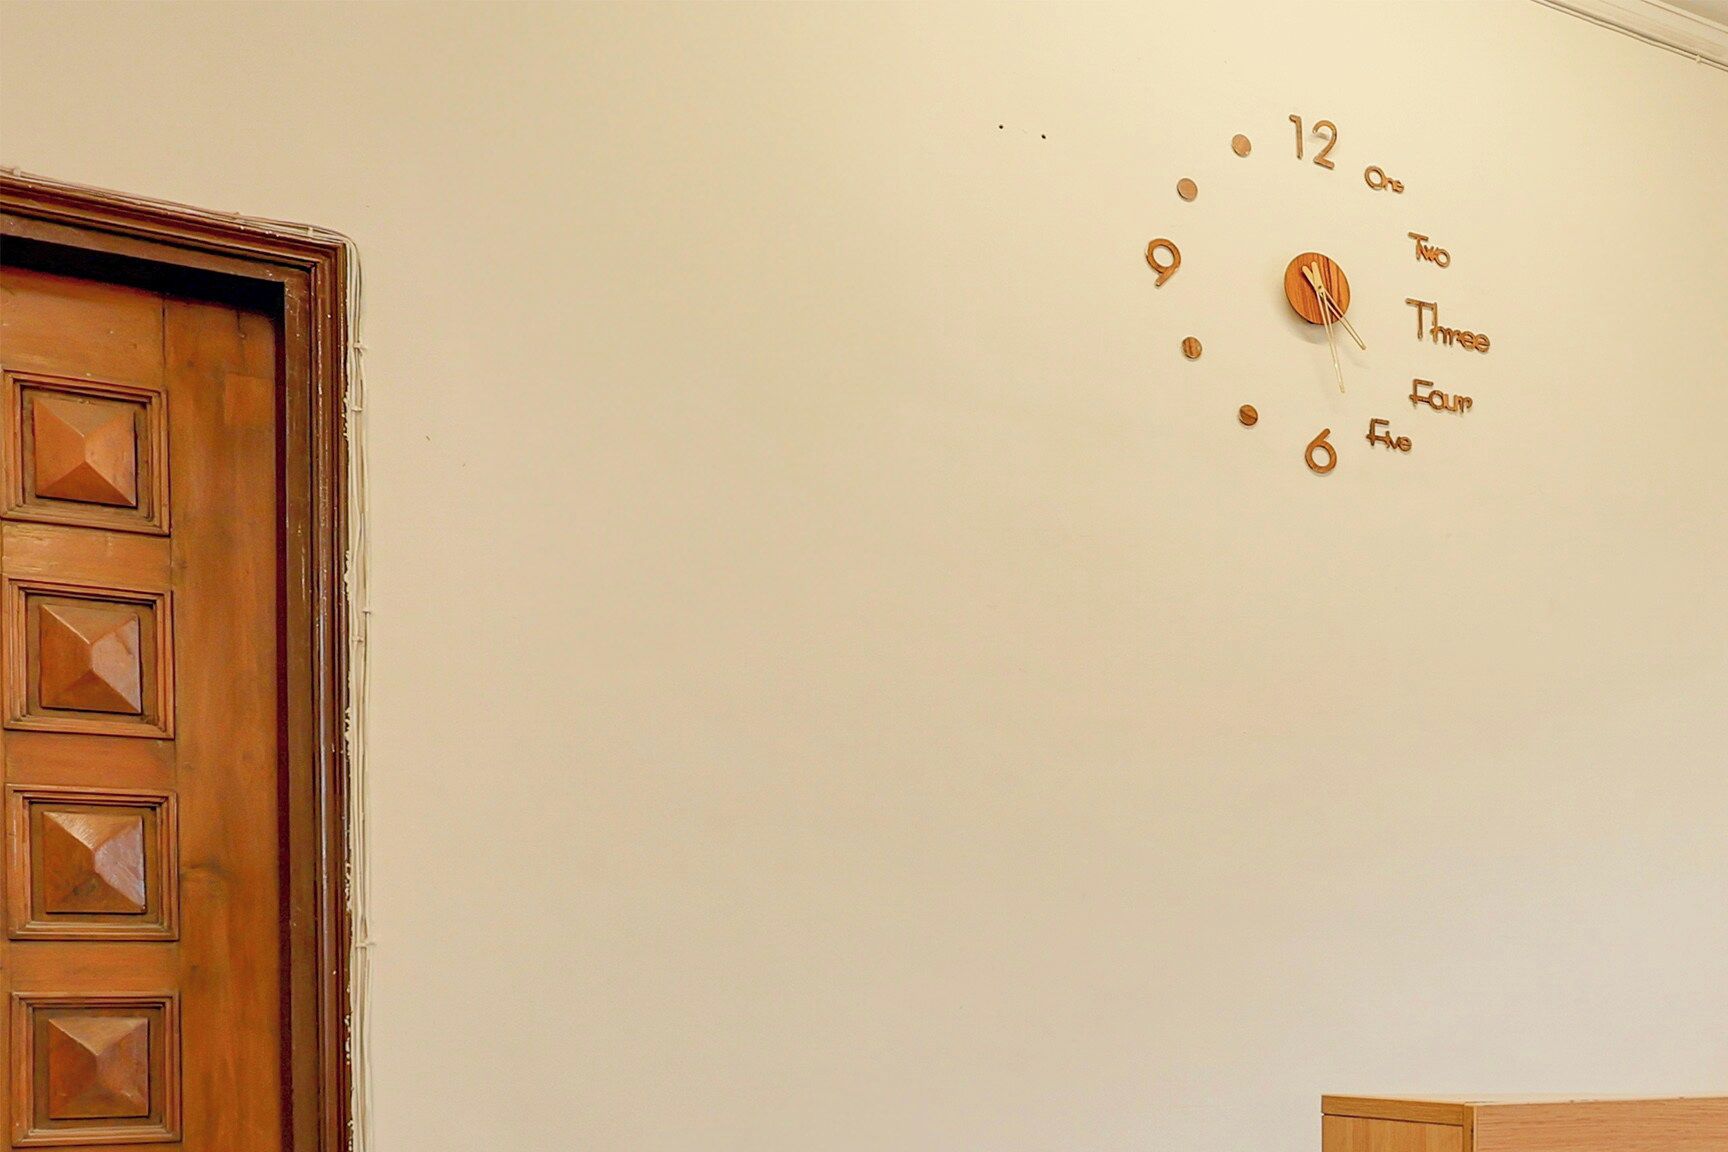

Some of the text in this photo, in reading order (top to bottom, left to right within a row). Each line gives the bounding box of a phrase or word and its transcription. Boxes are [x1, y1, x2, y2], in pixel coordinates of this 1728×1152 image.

[1289, 114, 1338, 169] 12
[1364, 166, 1405, 194] One
[1145, 238, 1182, 288] 9
[1407, 231, 1452, 269] Two
[1405, 298, 1491, 354] Three
[1409, 379, 1474, 415] Four
[1304, 428, 1338, 475] 6
[1366, 418, 1413, 453] Five
